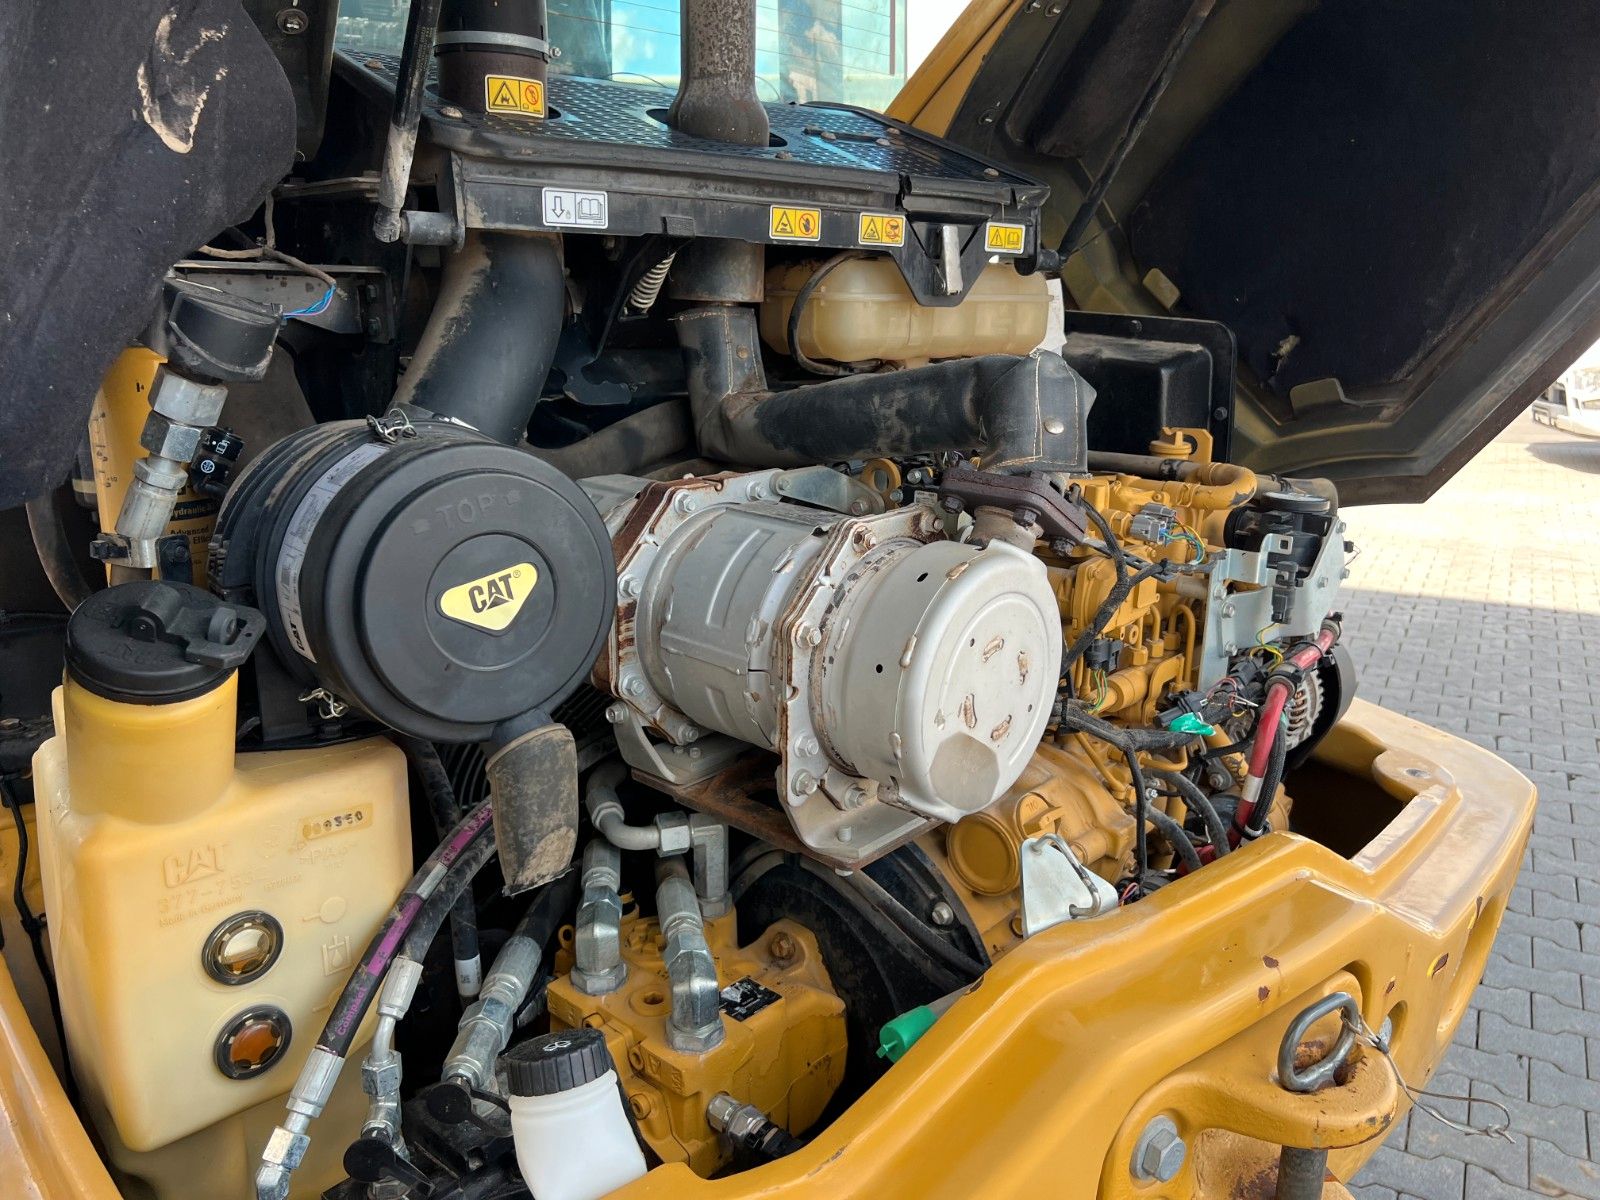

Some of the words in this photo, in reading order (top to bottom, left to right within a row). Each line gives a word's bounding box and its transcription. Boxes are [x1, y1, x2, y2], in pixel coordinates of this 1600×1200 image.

[435, 494, 494, 529] TOP
[468, 573, 514, 614] CAT
[163, 842, 228, 888] CAT
[337, 986, 367, 1036] Compact
